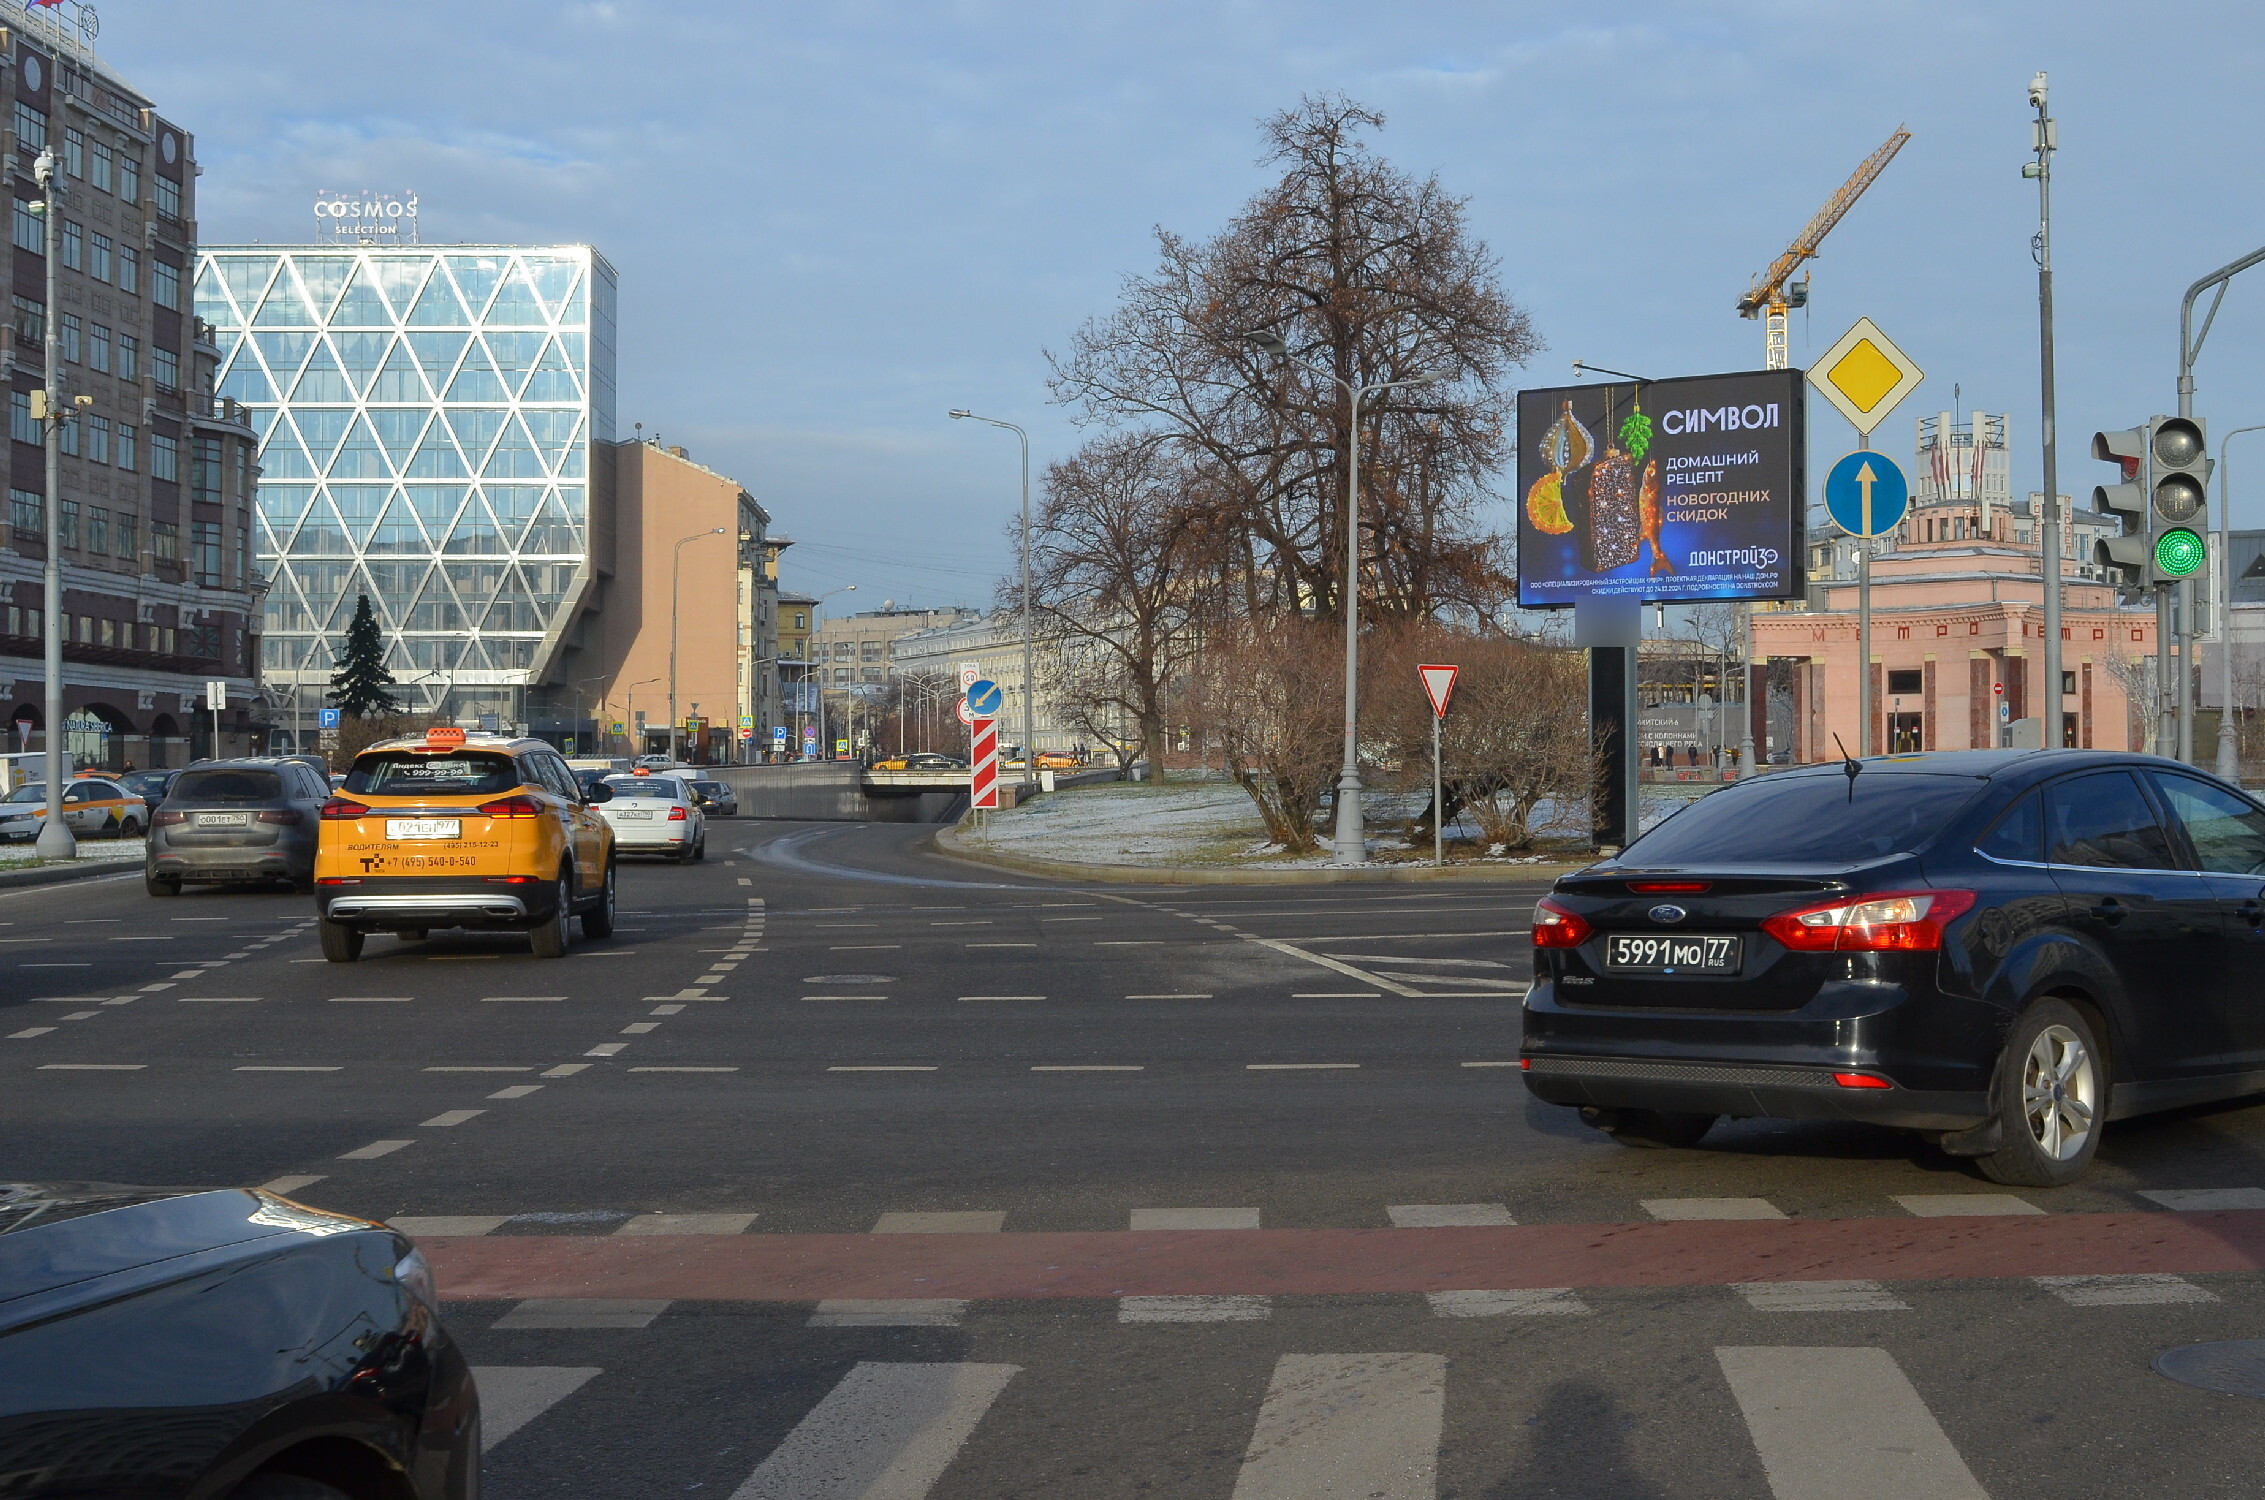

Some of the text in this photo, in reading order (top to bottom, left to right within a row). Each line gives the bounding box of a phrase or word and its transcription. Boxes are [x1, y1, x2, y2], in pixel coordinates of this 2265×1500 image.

[314, 200, 418, 218] COSMOS
[335, 226, 397, 234] SELECTION
[1662, 403, 1779, 435] СИМВОЛ
[1666, 449, 1759, 471] ДОМАШНИЙ
[1666, 470, 1725, 486] РЕЦЕПТ
[1666, 489, 1771, 507] НОВОГОДНИХ
[1666, 507, 1728, 523] СКИДОК
[1688, 545, 1757, 567] ДОНСТРОЙ
[965, 674, 975, 682] 50
[324, 711, 335, 726] P
[412, 769, 464, 777] 999-99-99
[347, 843, 400, 851] ВОДИТЕЛЯМ
[387, 856, 476, 869] +7 (495) 540-0-540
[1707, 939, 1730, 959] 77
[1707, 958, 1725, 967] RUS
